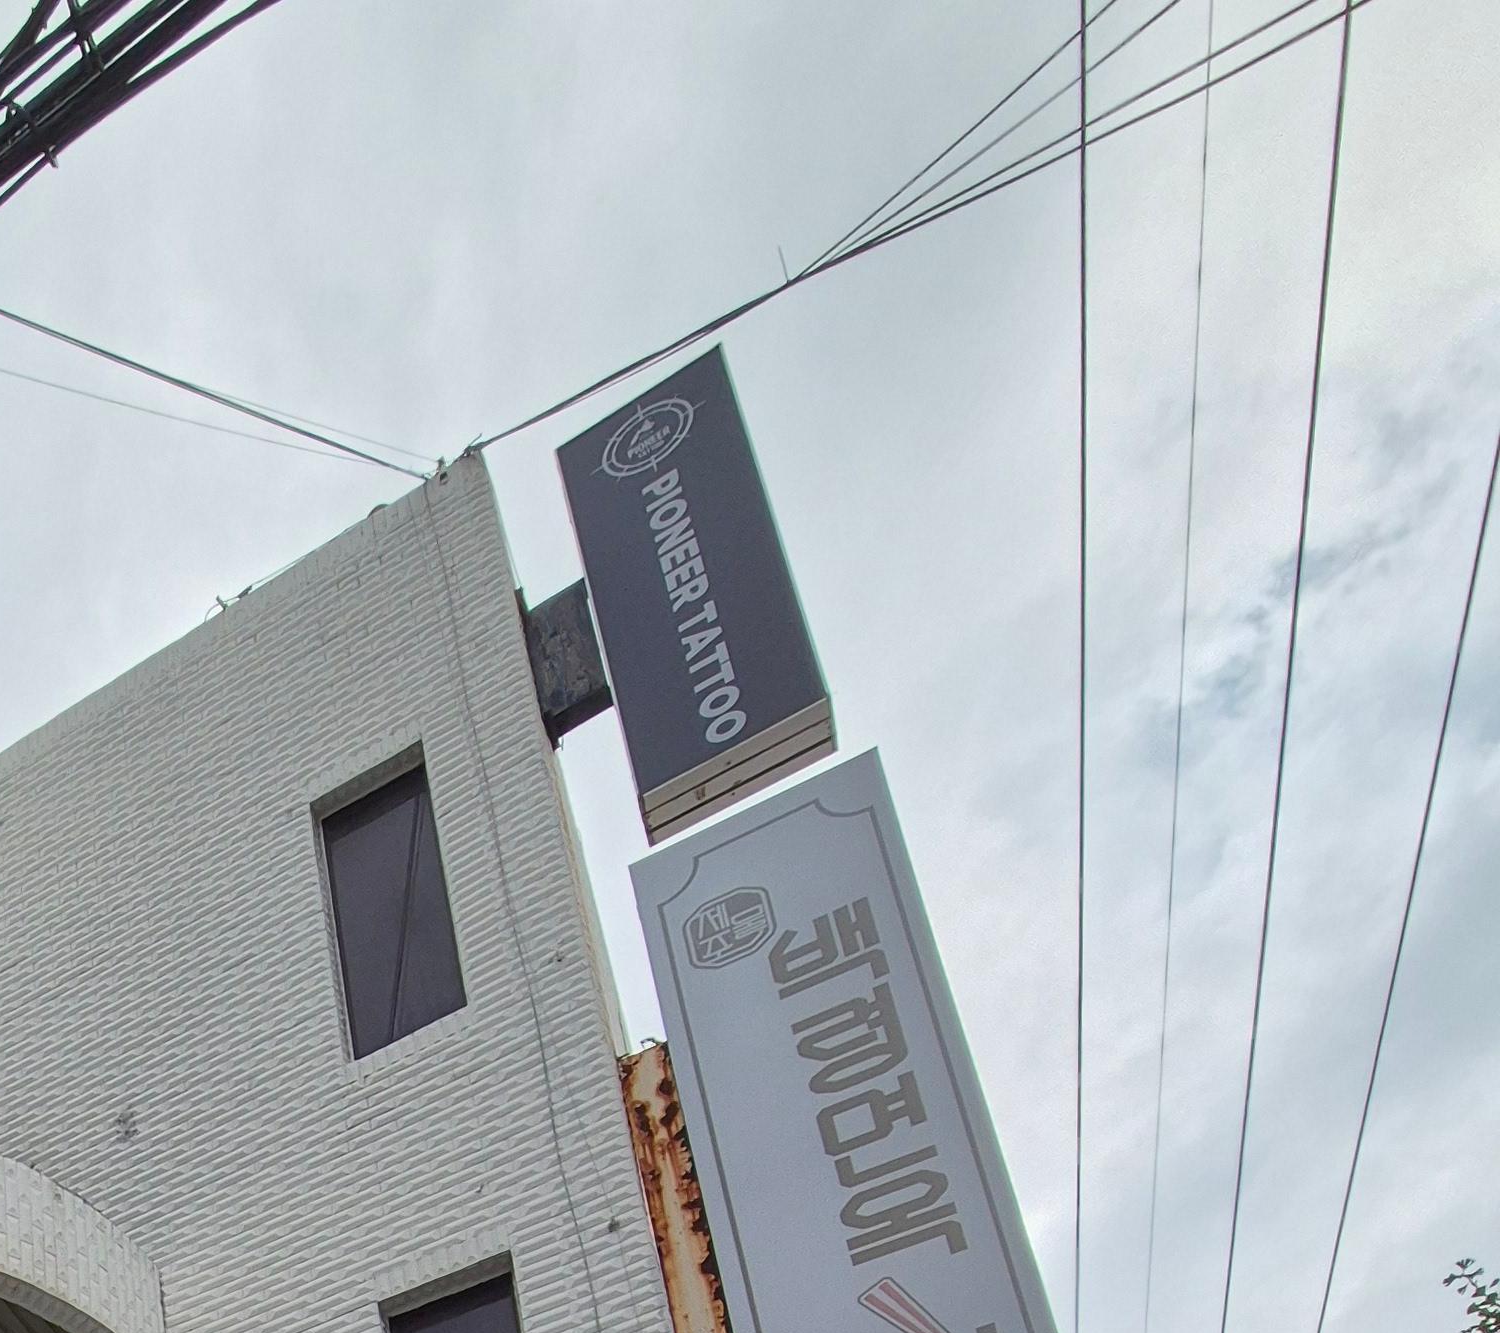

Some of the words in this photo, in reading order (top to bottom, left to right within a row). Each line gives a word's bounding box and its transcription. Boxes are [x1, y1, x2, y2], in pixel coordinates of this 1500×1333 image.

[641, 468, 709, 613] PIONEER
[678, 600, 747, 744] TATTOO
[767, 896, 968, 1267] 백령면옥
